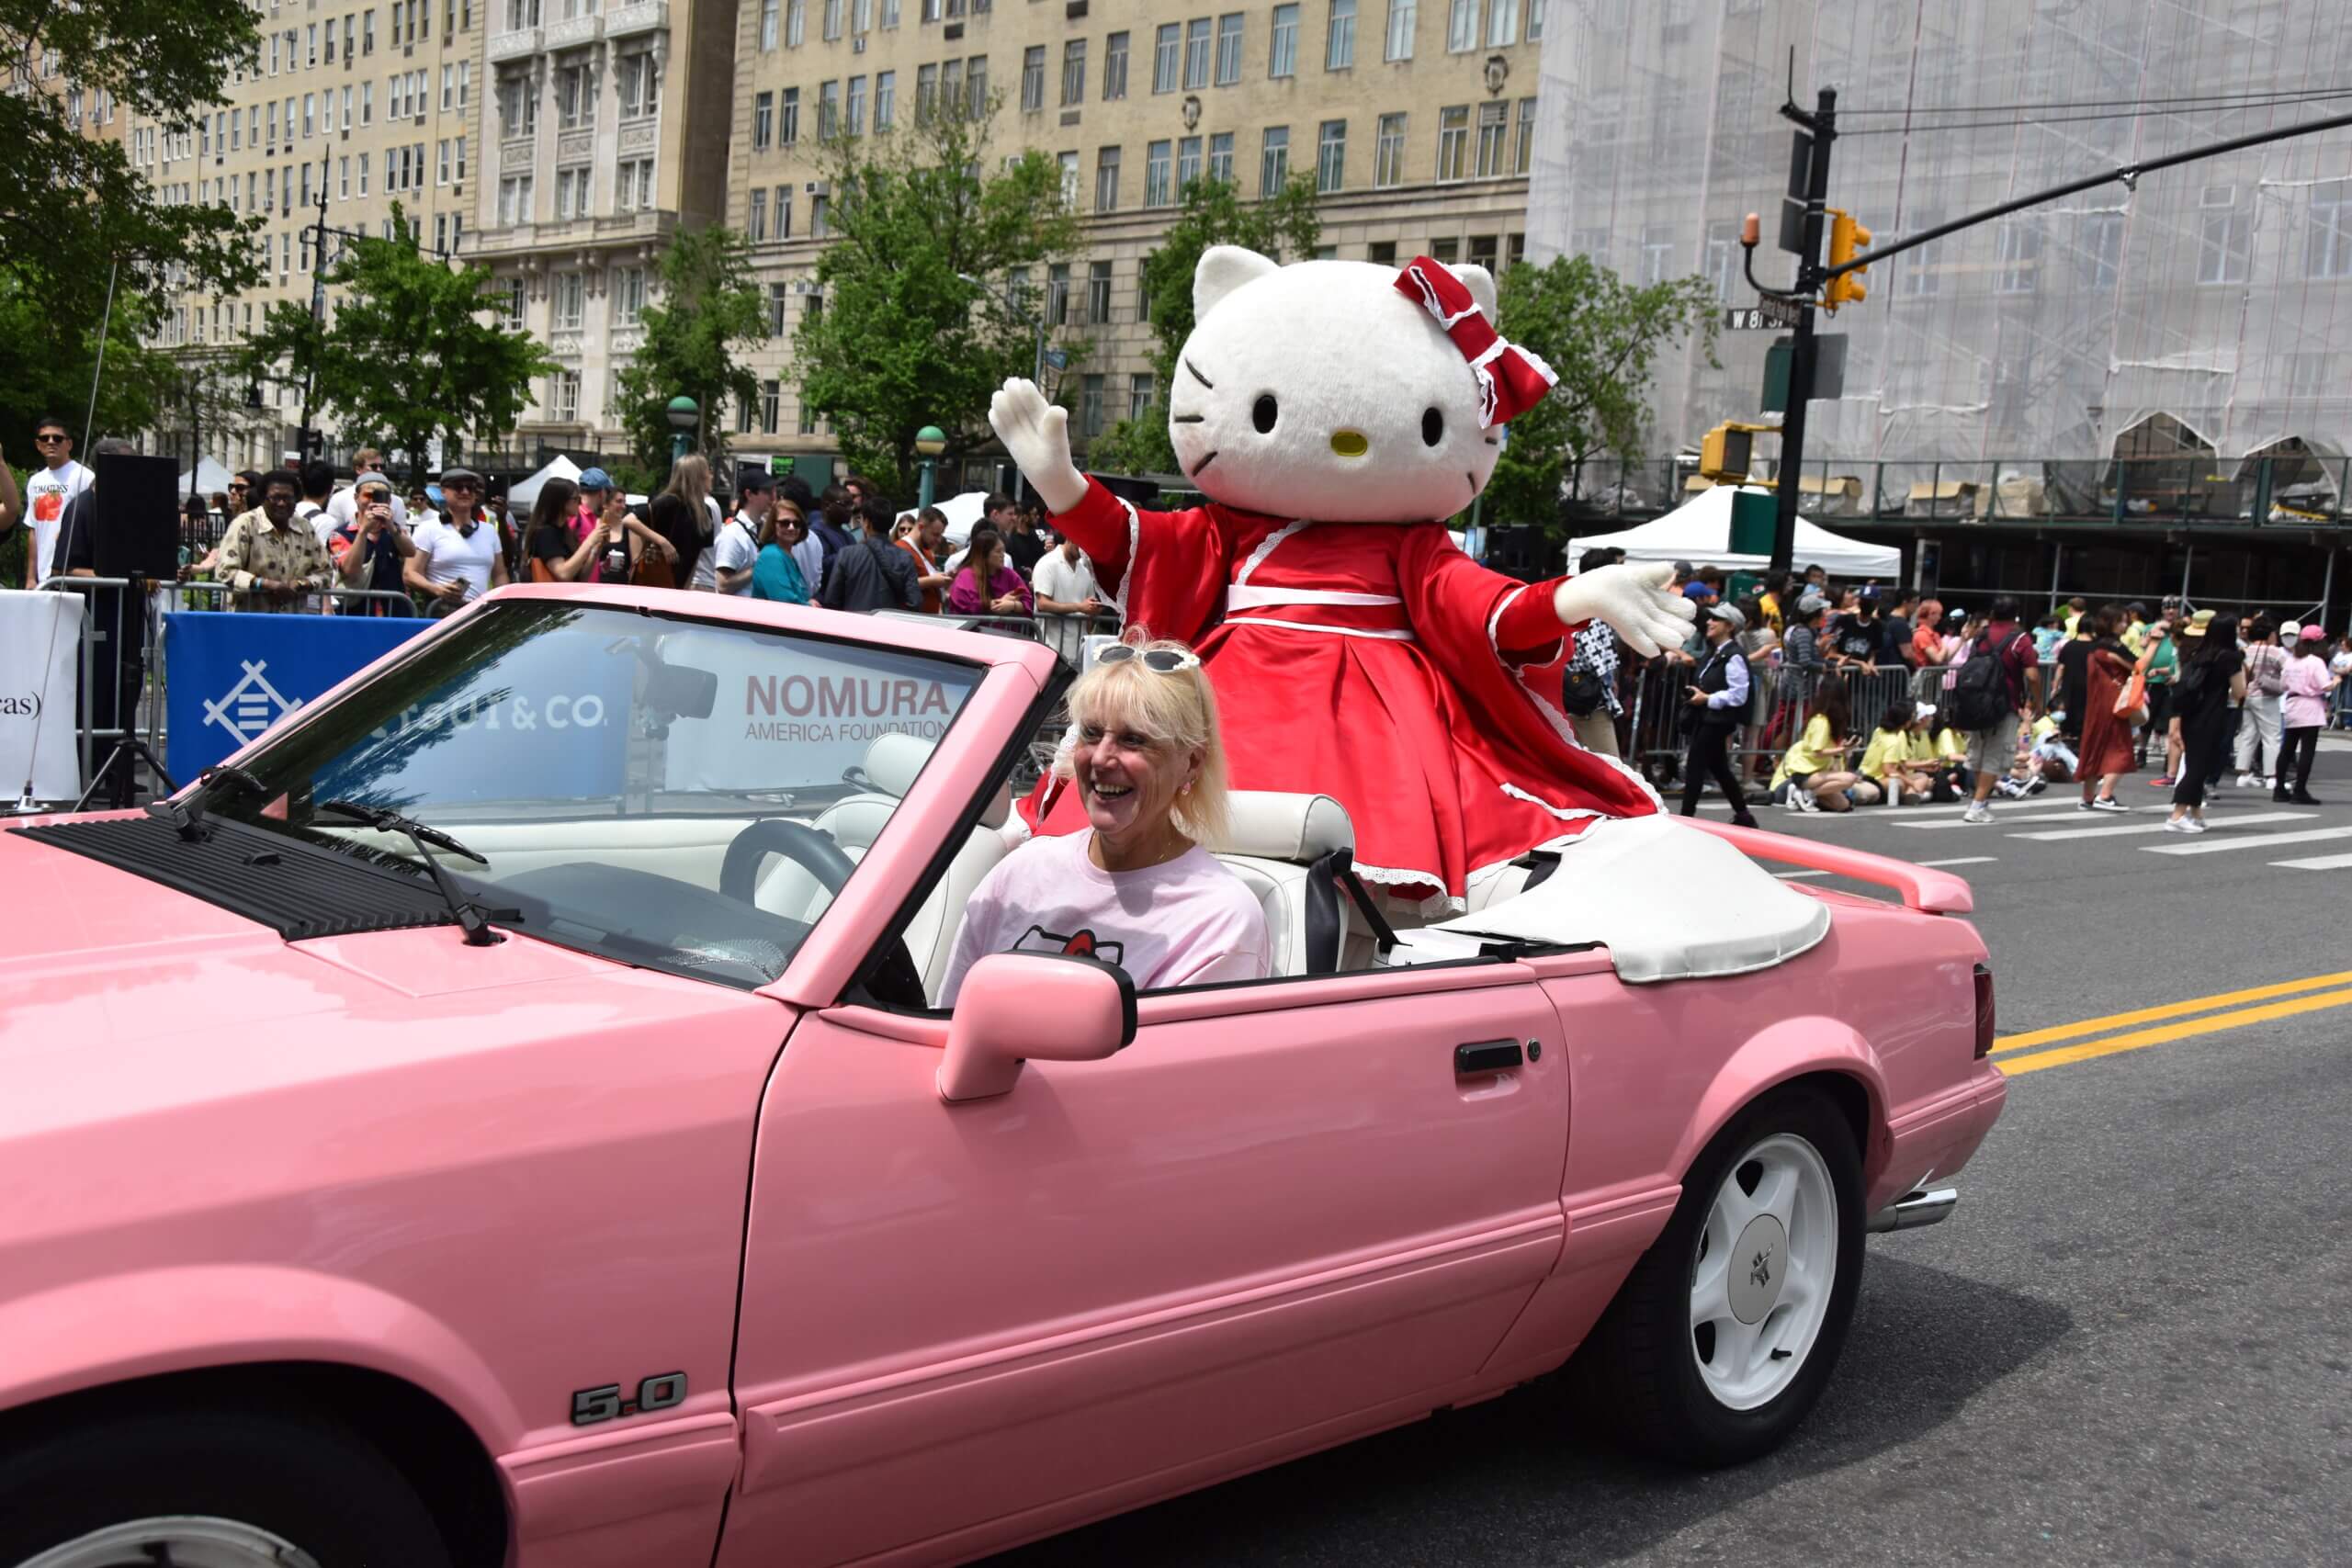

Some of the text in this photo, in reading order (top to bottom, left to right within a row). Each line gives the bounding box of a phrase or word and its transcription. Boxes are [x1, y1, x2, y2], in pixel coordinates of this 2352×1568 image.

[1733, 310, 1746, 329] W
[1748, 310, 1763, 329] 81
[0, 690, 41, 720] as)
[512, 695, 537, 731] &
[545, 694, 608, 728] CO.
[746, 675, 950, 717] NOMURA
[744, 722, 834, 742] AMERICA
[571, 1371, 687, 1427] 5.0
